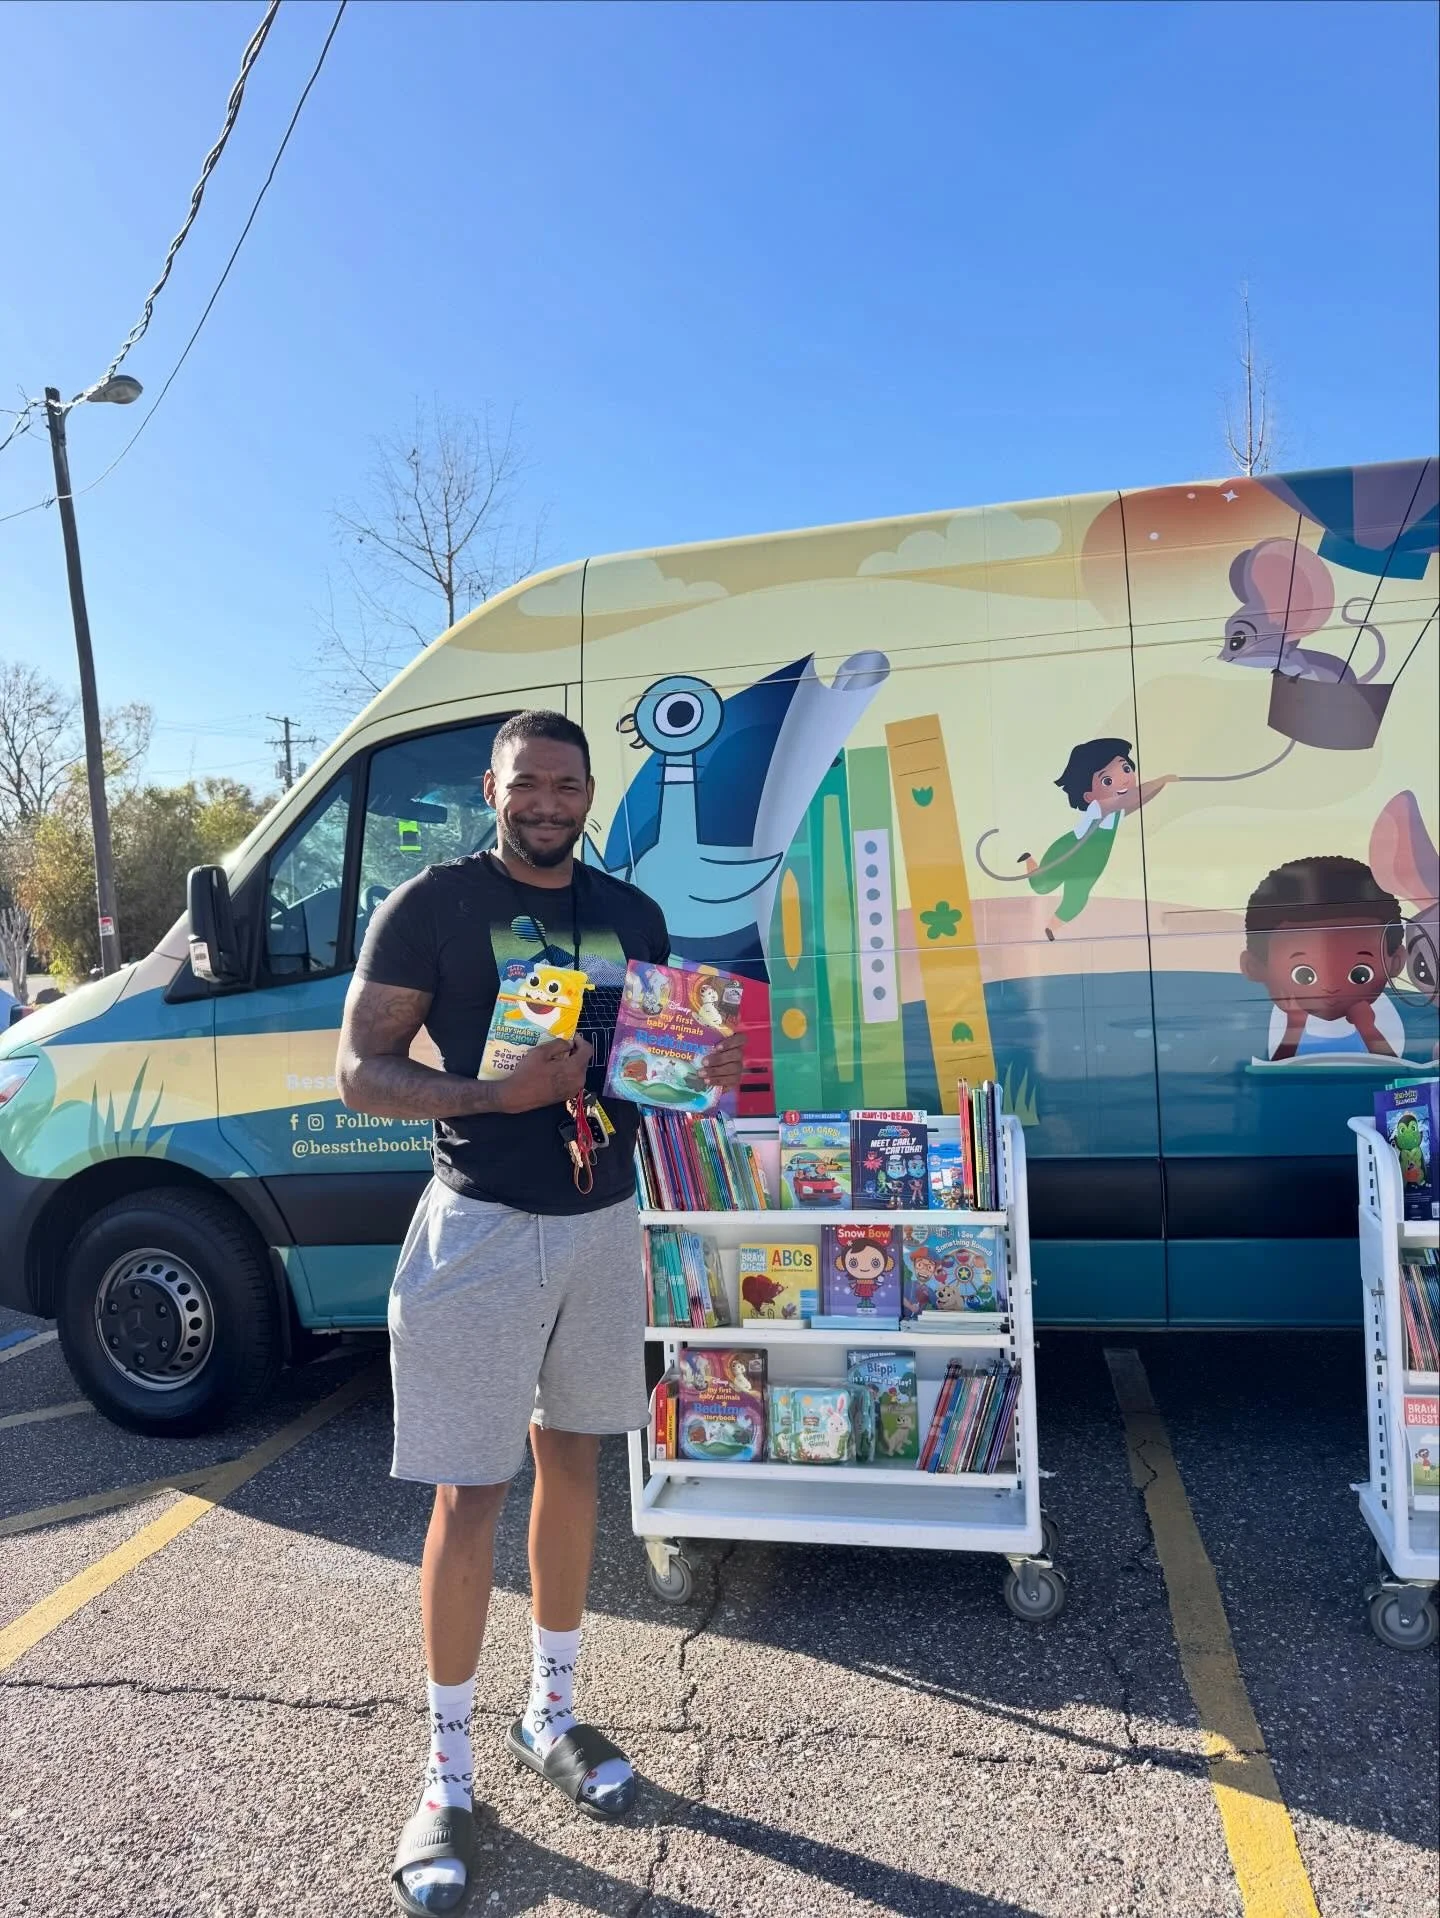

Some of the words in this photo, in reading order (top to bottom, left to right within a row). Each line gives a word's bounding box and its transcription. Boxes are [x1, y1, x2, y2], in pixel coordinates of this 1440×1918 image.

[660, 1013, 674, 1021] my
[675, 1014, 694, 1026] first
[646, 1017, 669, 1030] baby
[670, 1023, 704, 1036] animals
[647, 1046, 694, 1061] storybook
[335, 1113, 395, 1128] Follow
[870, 1139, 891, 1148] MEET
[892, 1137, 917, 1147] CARLY
[838, 1229, 866, 1238] Snow
[868, 1229, 890, 1238] Bow
[771, 1250, 812, 1267] ABCs
[867, 1362, 897, 1377] Blippi
[719, 1385, 731, 1393] first
[699, 1393, 716, 1401] baby
[717, 1393, 740, 1401] animals
[1407, 1403, 1437, 1414] BRAIN
[1408, 1414, 1439, 1424] QUEST
